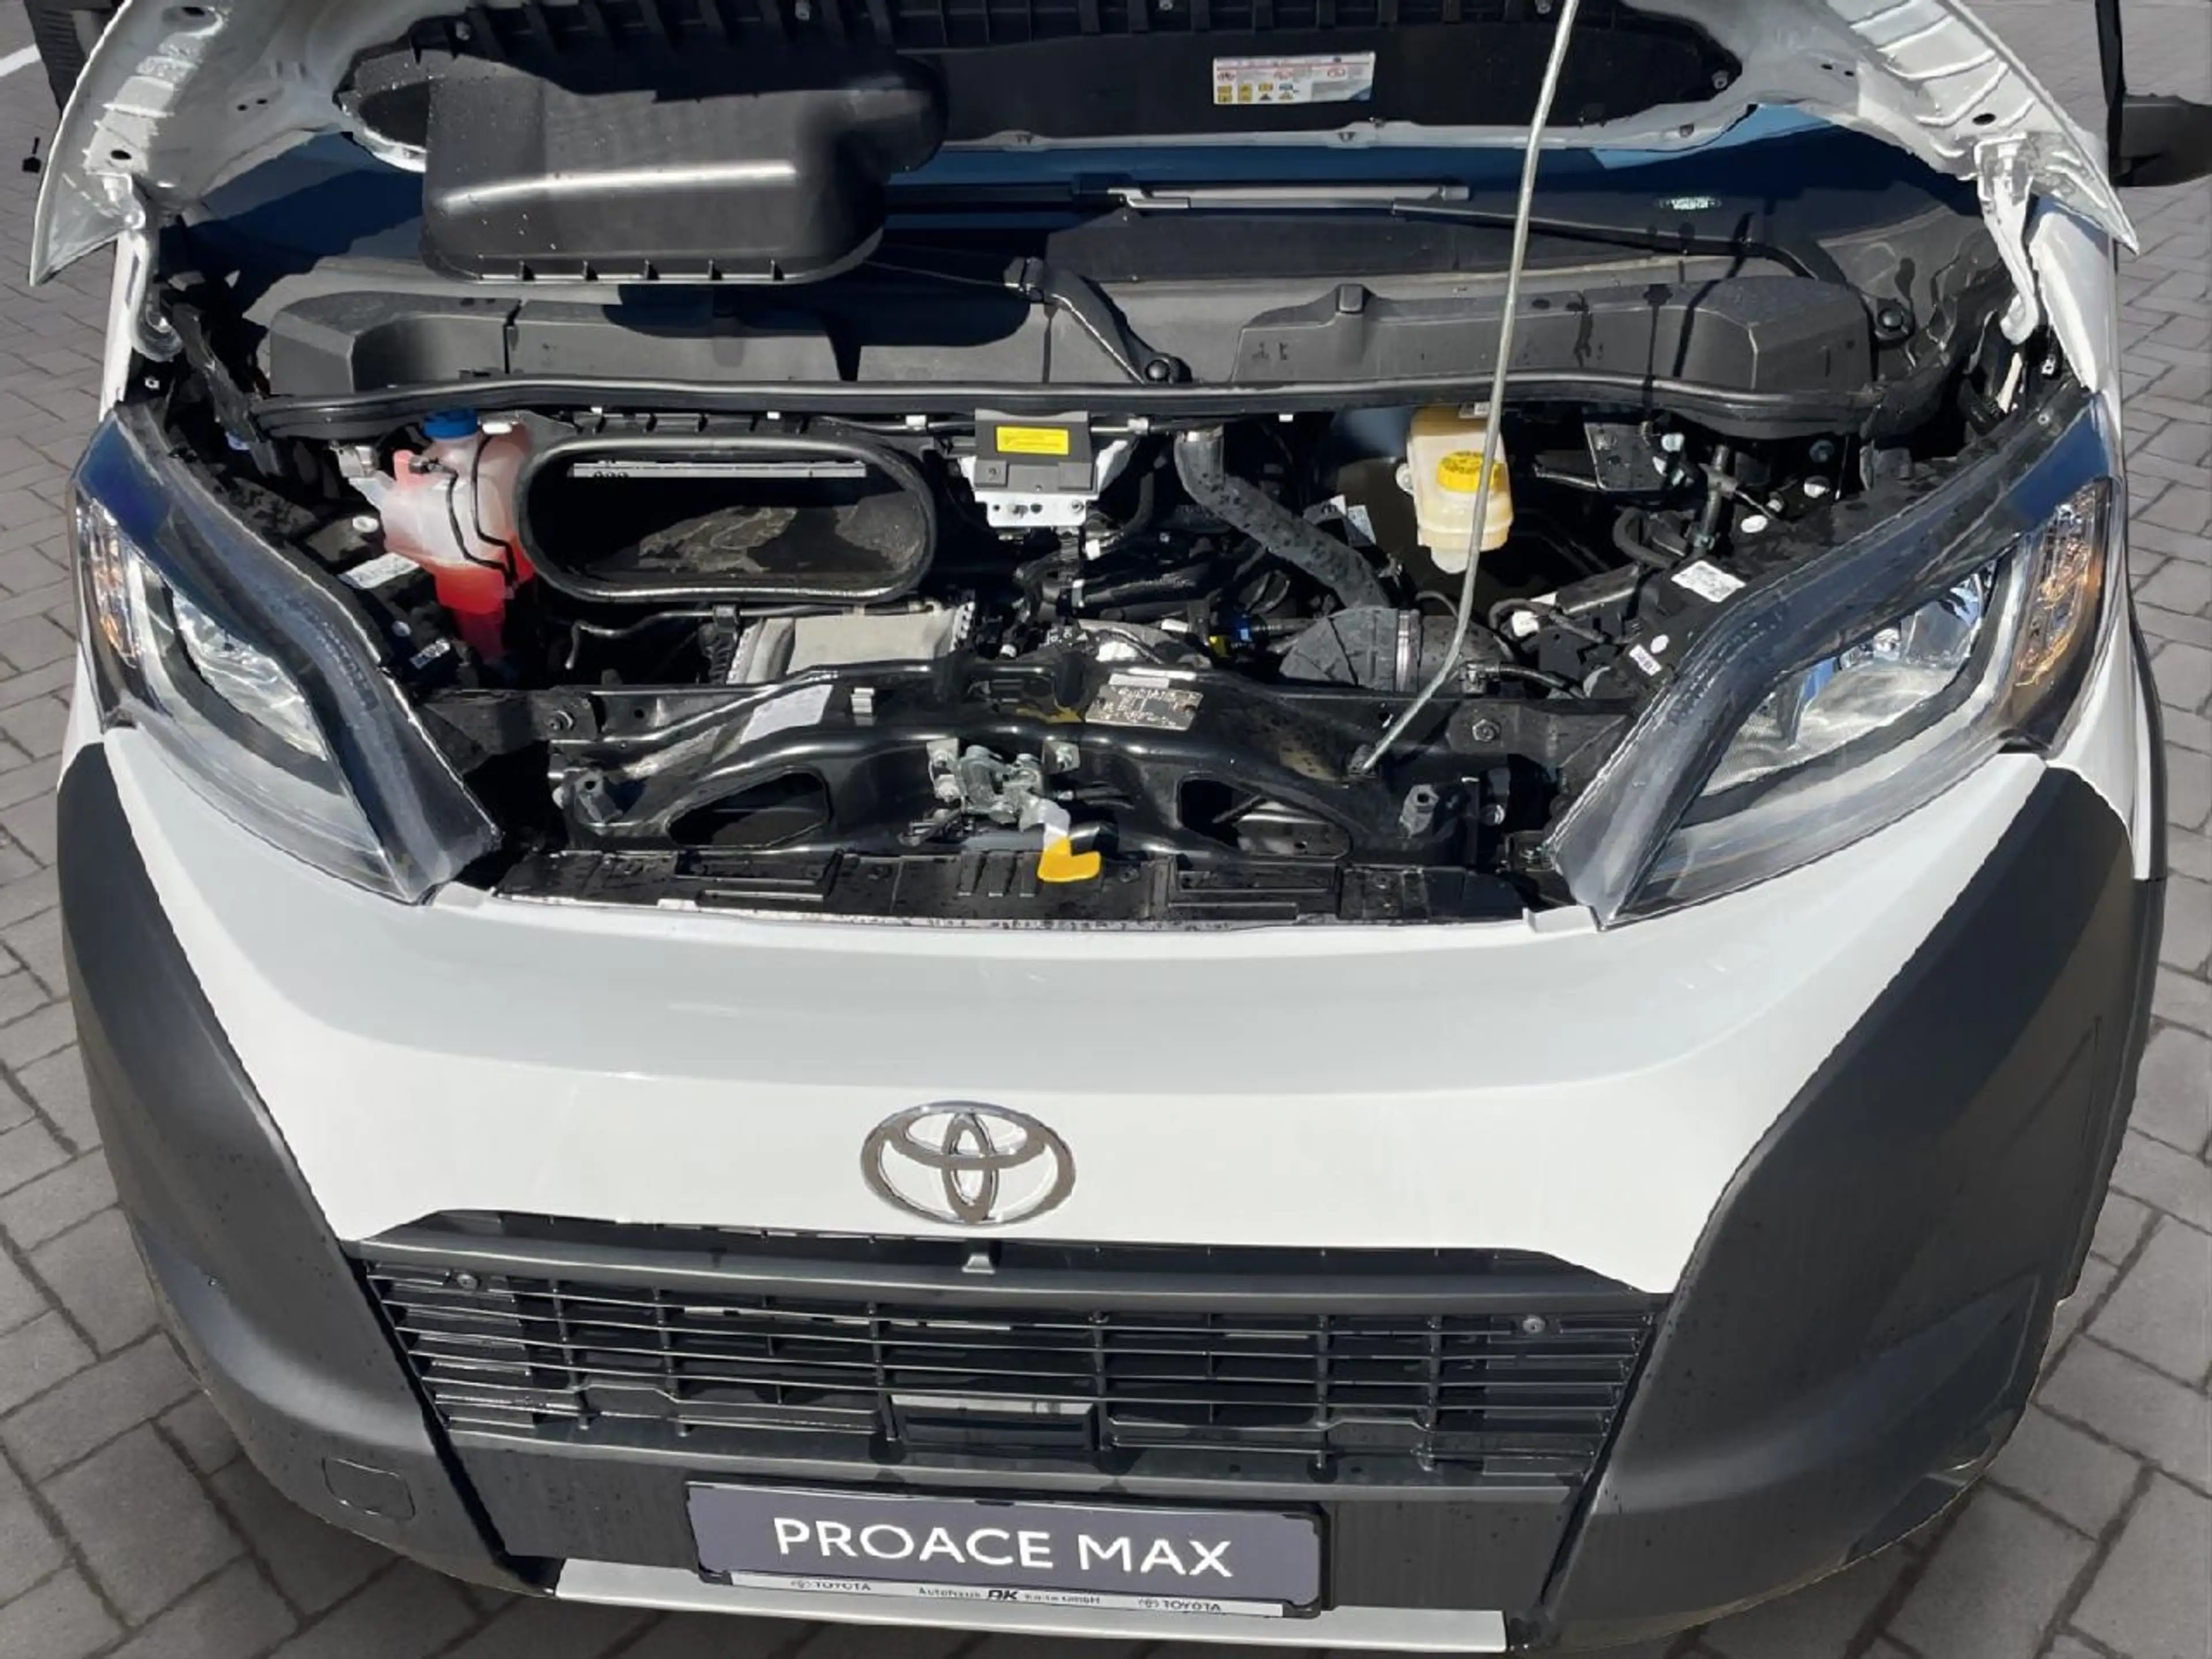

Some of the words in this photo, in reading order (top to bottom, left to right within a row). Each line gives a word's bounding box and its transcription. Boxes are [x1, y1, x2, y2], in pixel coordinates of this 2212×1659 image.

[773, 1517, 1054, 1569] PROACE
[1077, 1534, 1234, 1578] MAX
[815, 1581, 871, 1591] TOYOTA
[1162, 1600, 1221, 1612] TOYOTA
